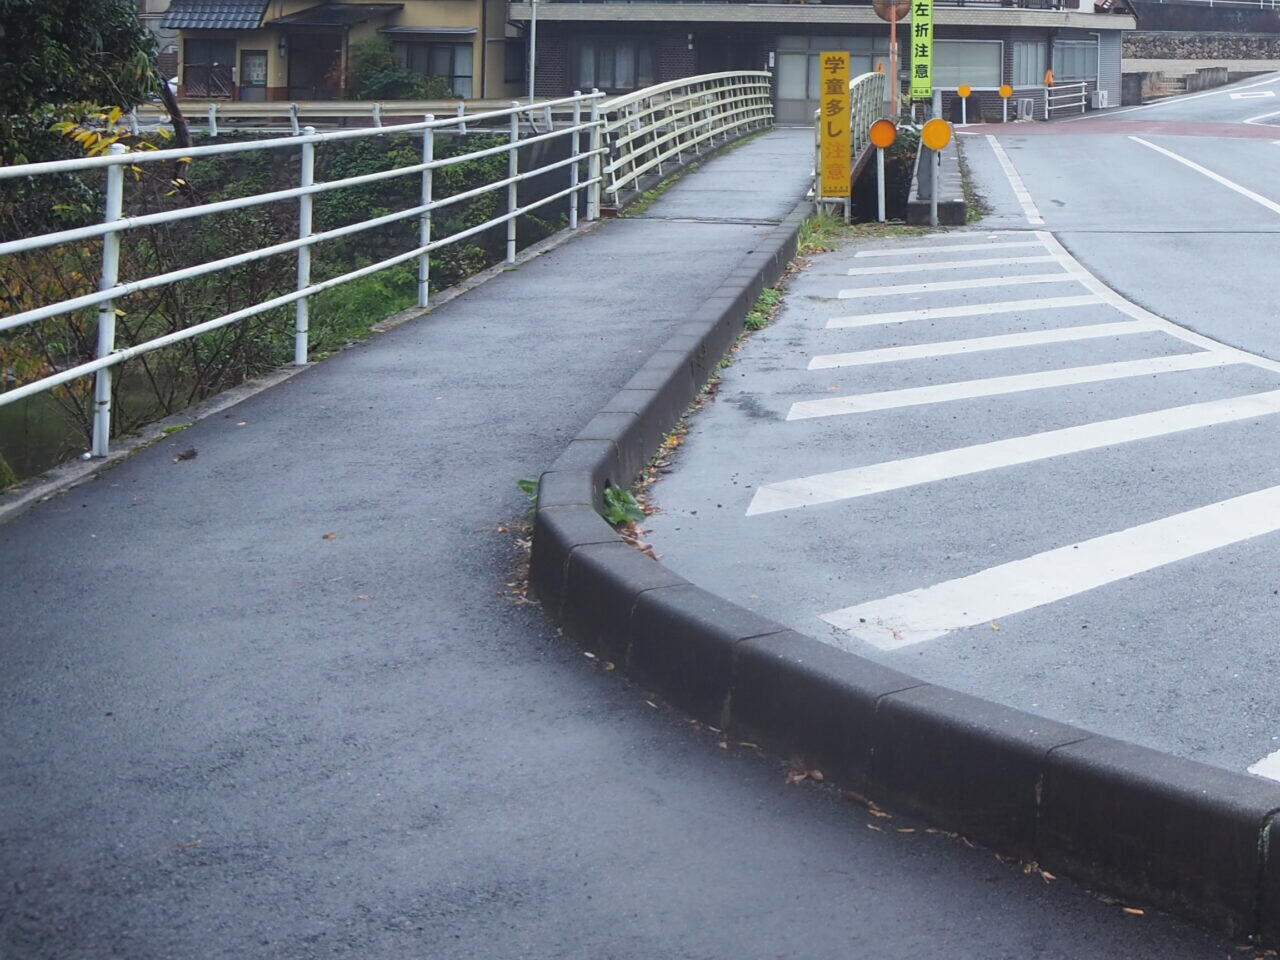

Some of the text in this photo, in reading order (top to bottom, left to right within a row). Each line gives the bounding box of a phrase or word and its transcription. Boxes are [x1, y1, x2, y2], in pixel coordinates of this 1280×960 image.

[914, 2, 929, 79] 左折注意
[824, 56, 845, 180] 学童多し注意
